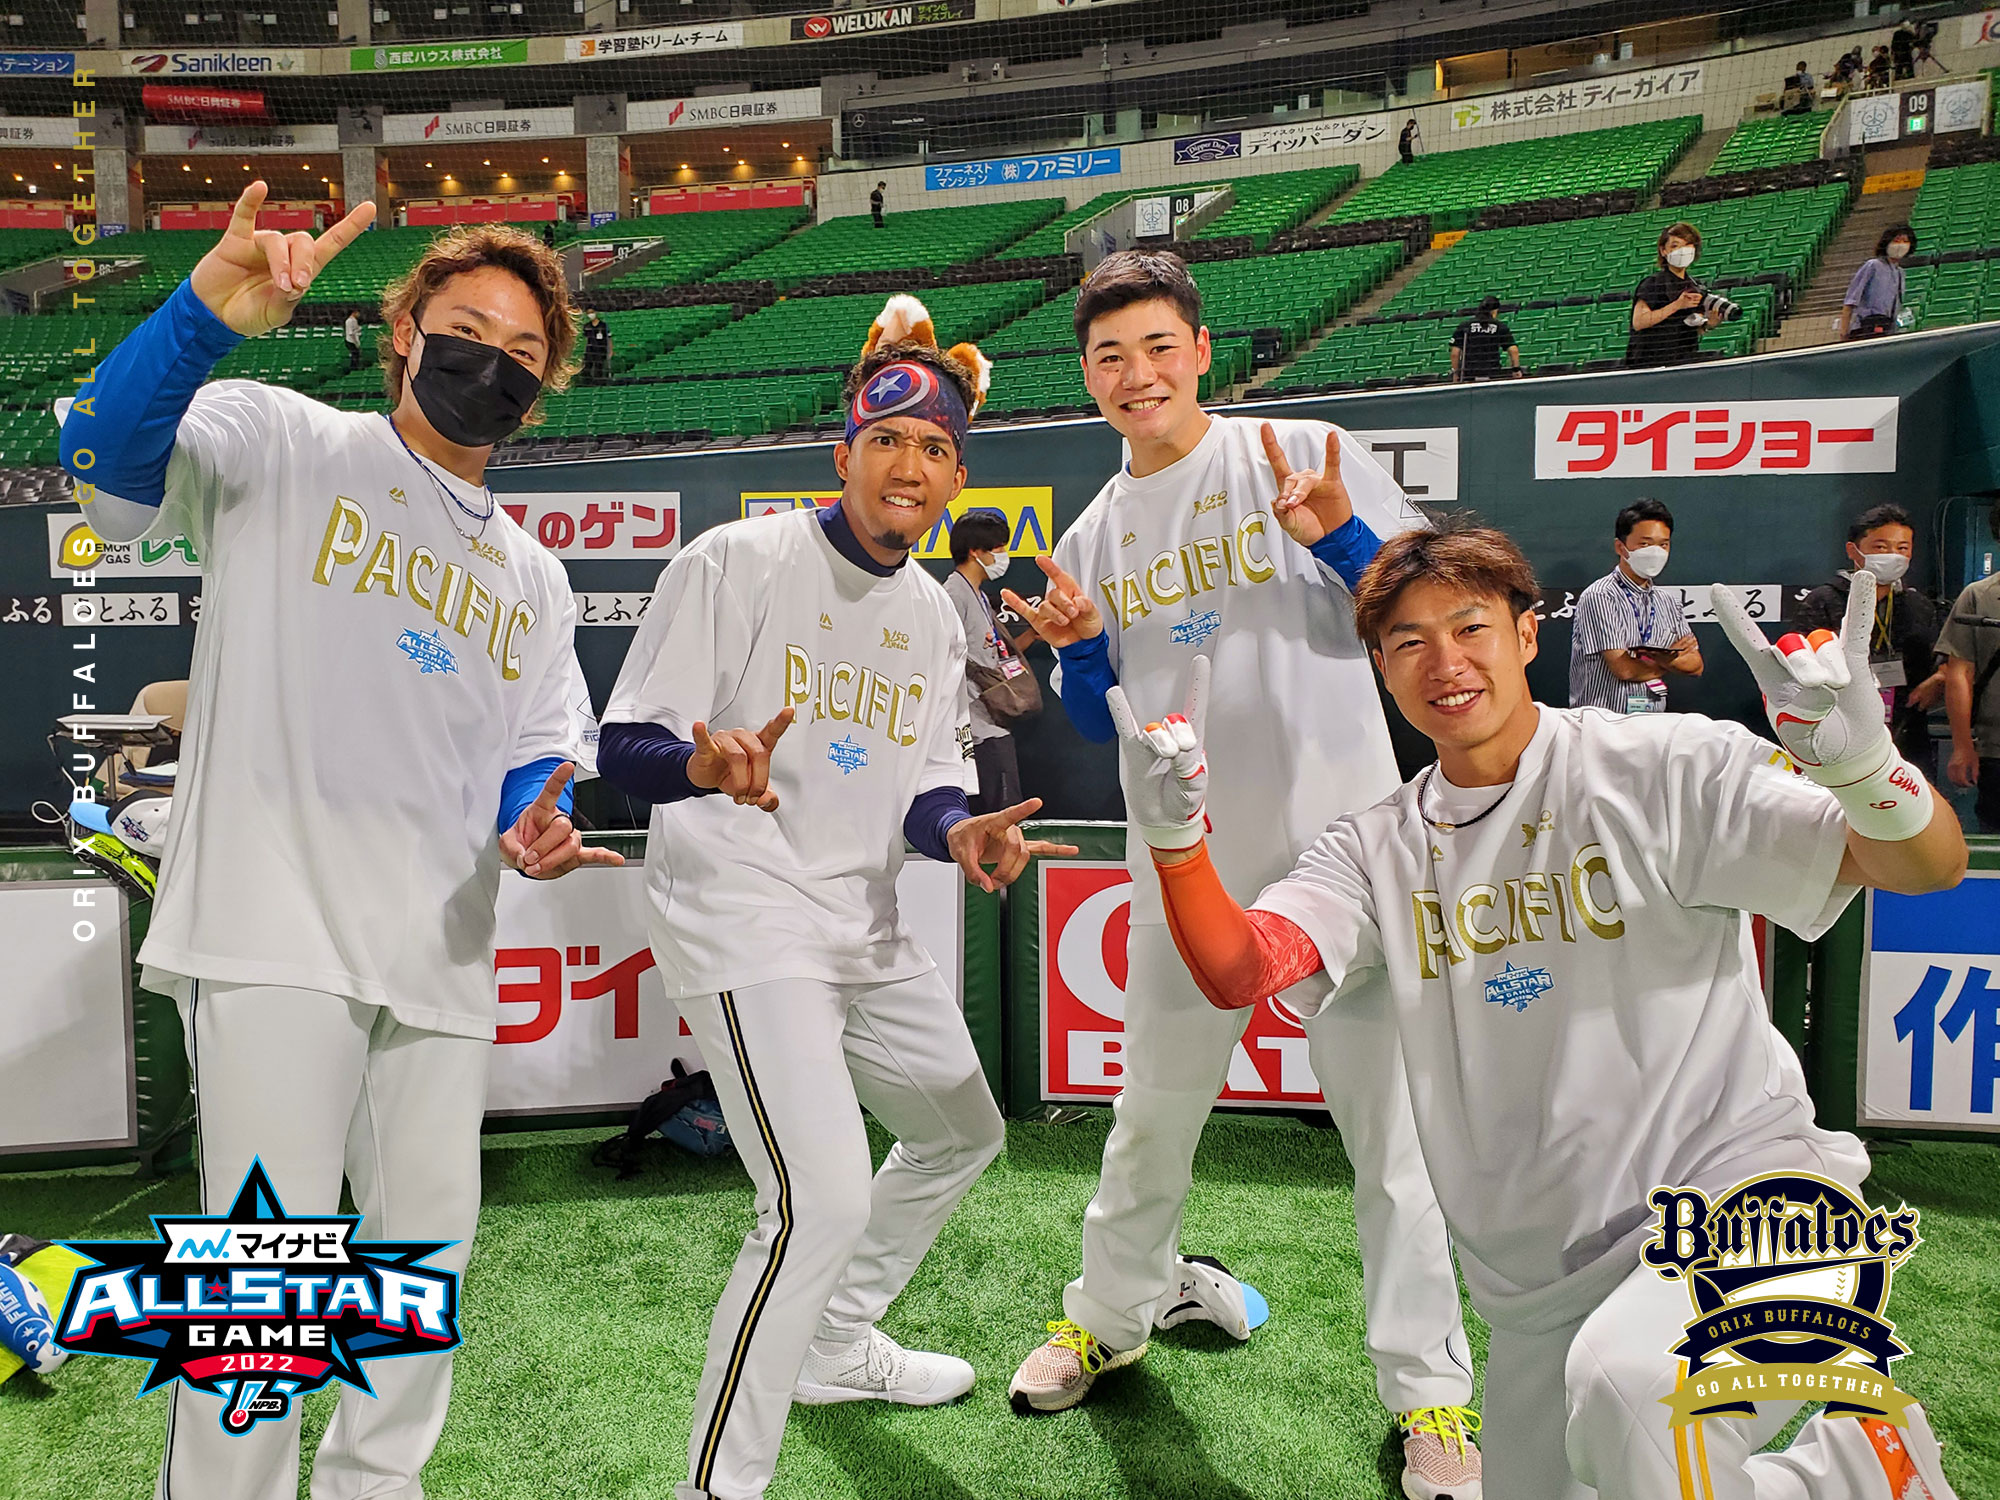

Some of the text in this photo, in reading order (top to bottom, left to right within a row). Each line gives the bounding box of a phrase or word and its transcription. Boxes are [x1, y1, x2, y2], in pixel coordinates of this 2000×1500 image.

[832, 7, 912, 33] WELUKAN
[598, 29, 728, 54] 学習塾ドリーム・チーム
[172, 53, 272, 72] Sanikleen
[389, 46, 503, 65] 西武ハウス株式会社
[690, 102, 778, 121] SMBC日興証券
[1908, 94, 1928, 113] 09
[1246, 126, 1386, 156] ディッパーダン
[934, 162, 993, 179] ファーネスト
[937, 175, 988, 188] マンション
[1175, 198, 1190, 214] 08
[1556, 408, 1875, 472] ダイショー
[106, 554, 131, 564] GAS
[312, 495, 538, 682] PACIFIC
